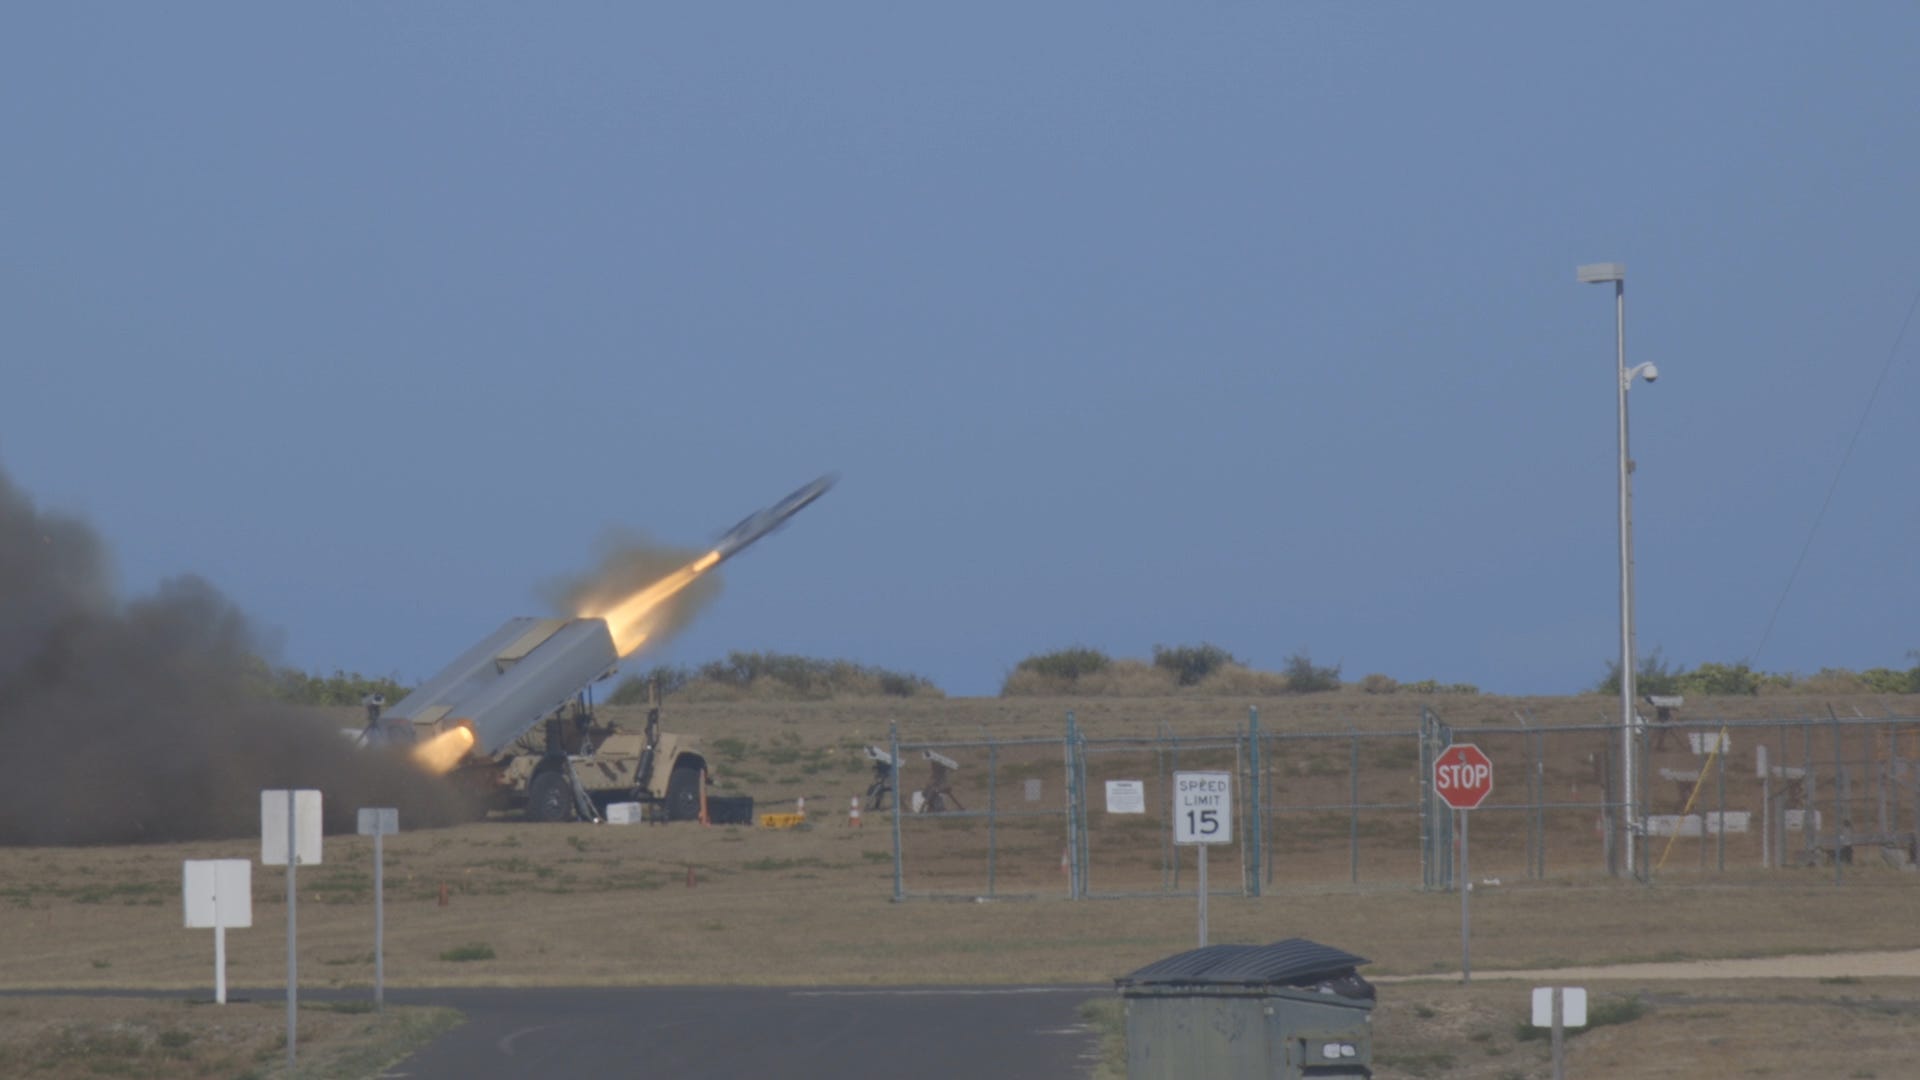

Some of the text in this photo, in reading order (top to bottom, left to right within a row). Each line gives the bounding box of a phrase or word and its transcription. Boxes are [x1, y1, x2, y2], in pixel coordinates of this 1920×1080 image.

[1438, 764, 1488, 789] STOP
[1179, 780, 1227, 792] SPEED
[1184, 795, 1220, 806] LIMIT
[1187, 810, 1219, 835] 15
